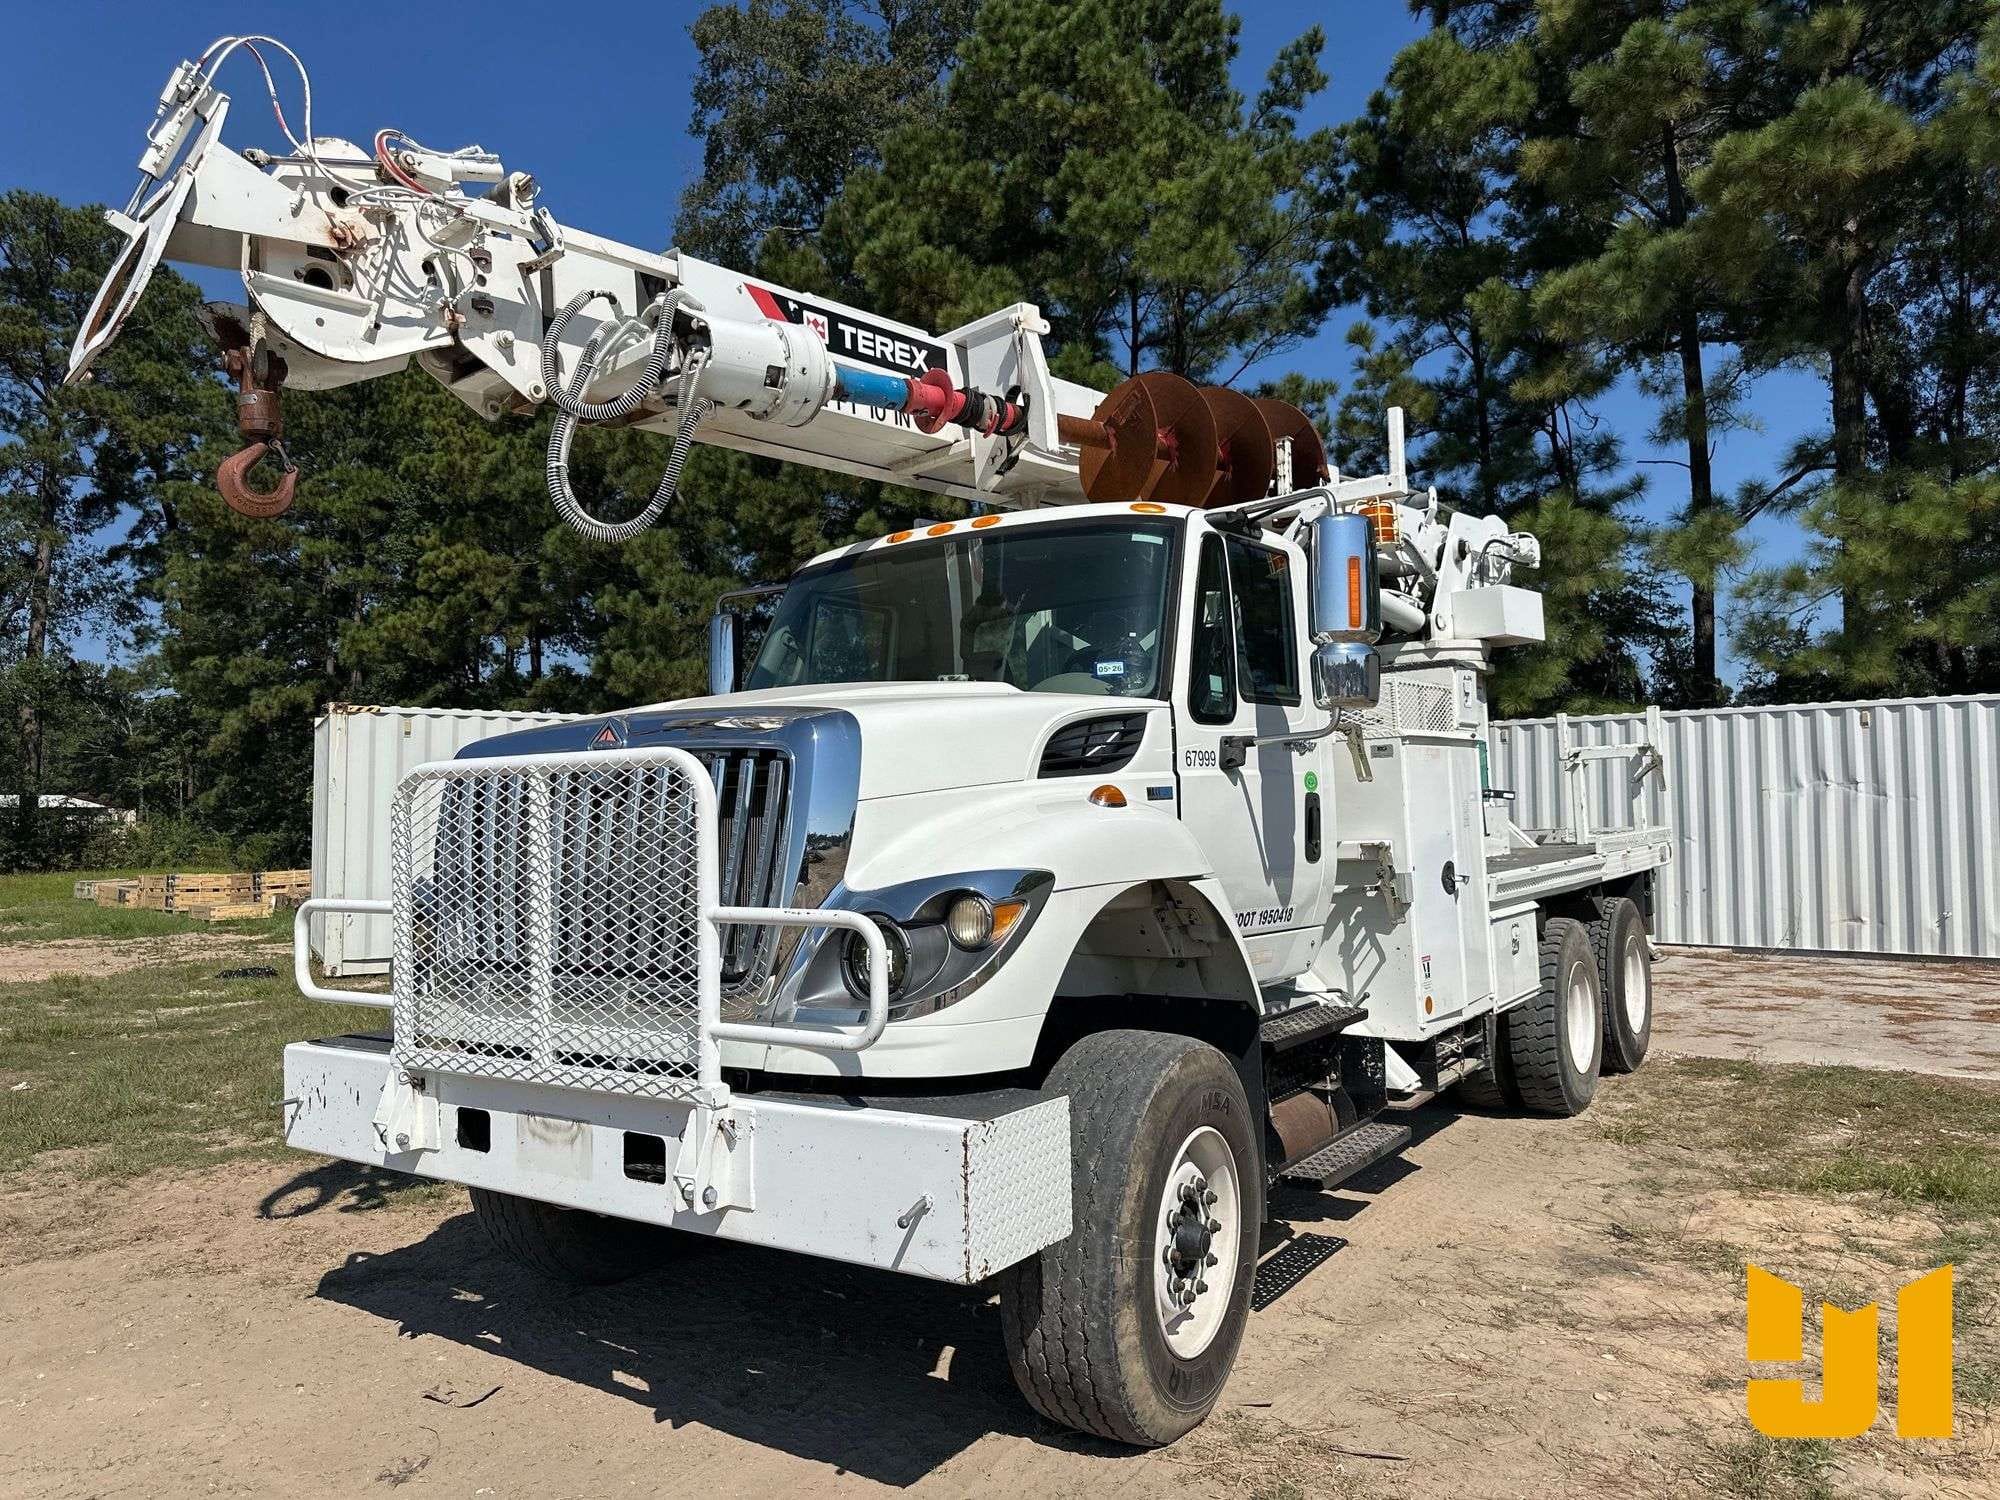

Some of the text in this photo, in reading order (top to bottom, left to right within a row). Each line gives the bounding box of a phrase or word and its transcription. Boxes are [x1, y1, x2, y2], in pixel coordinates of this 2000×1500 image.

[837, 322, 929, 373] TEREX
[1185, 750, 1217, 767] 67999
[1235, 907, 1294, 928] DOT 1950418
